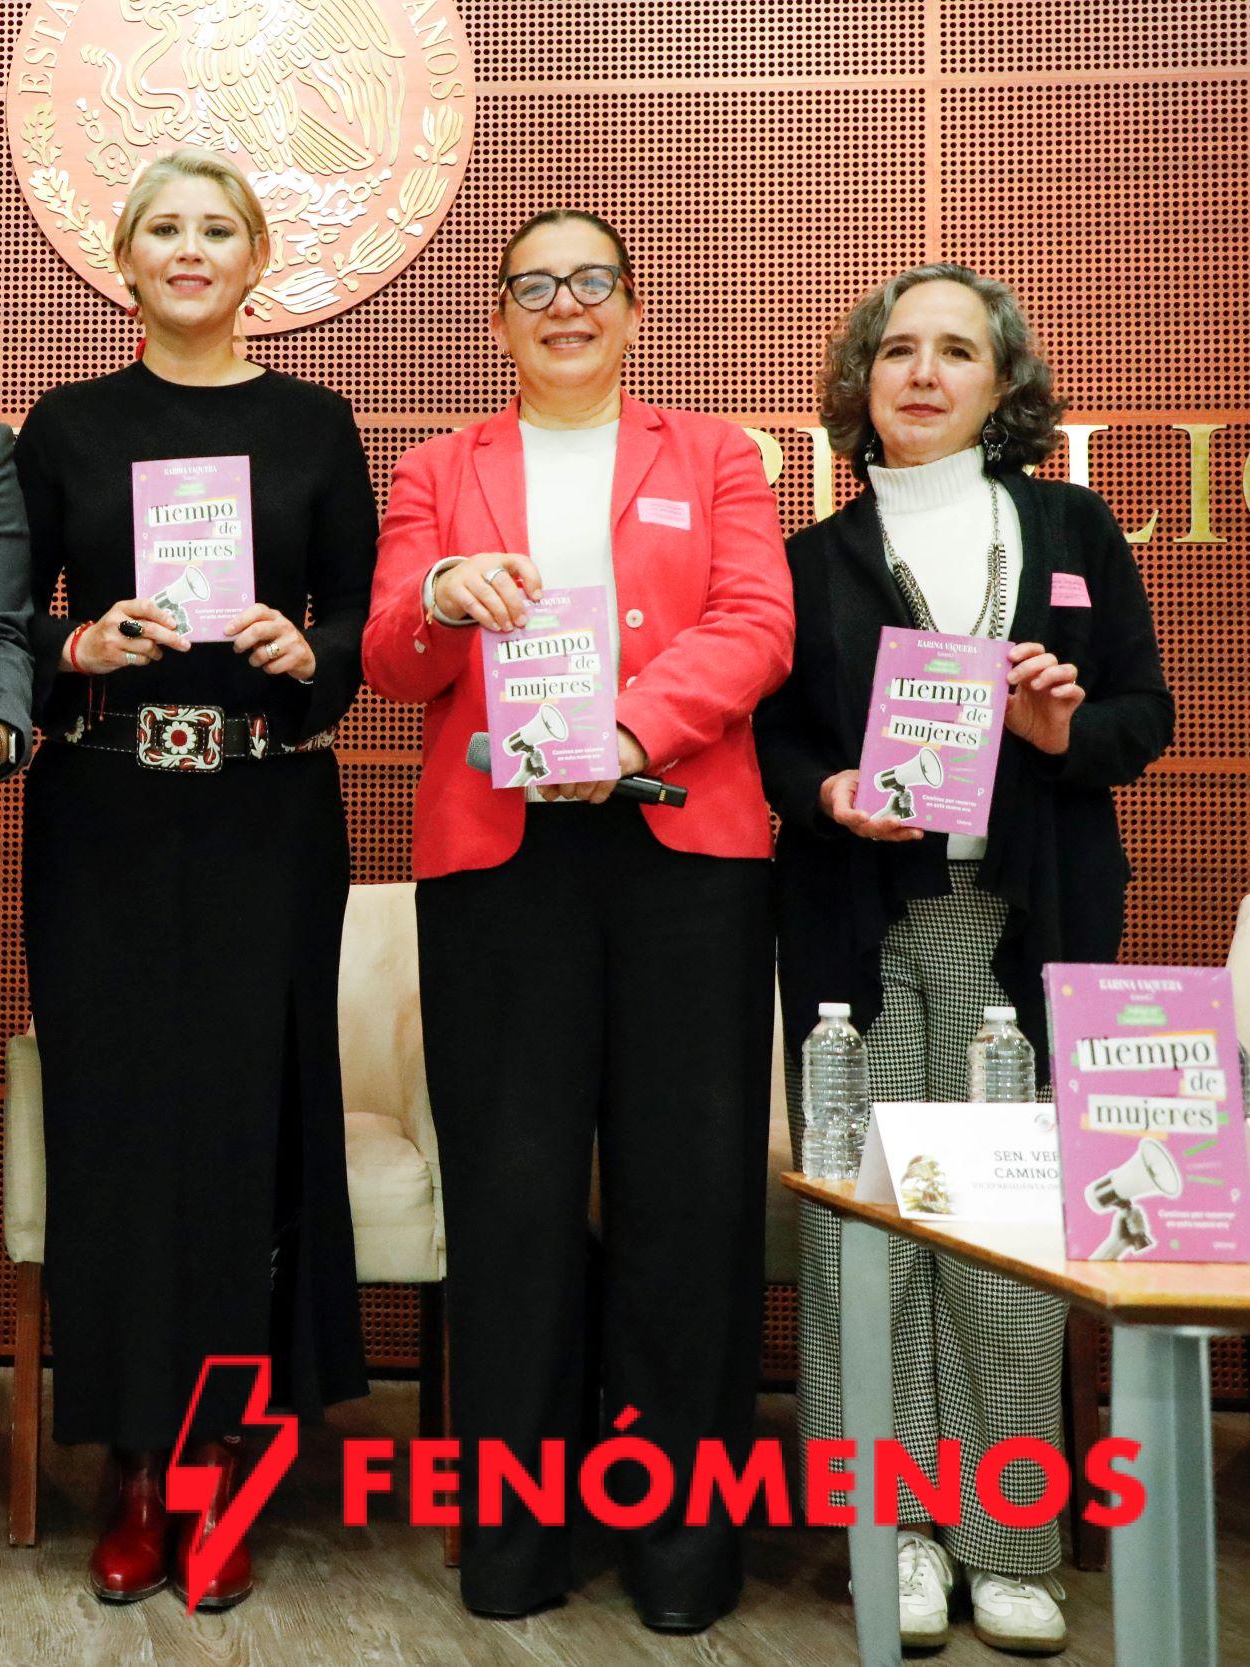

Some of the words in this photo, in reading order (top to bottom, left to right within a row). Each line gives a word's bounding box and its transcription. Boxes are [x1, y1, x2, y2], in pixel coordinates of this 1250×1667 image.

[150, 502, 233, 523] Tiempo
[219, 522, 237, 535] de
[158, 542, 233, 561] mujeres
[501, 634, 590, 661] Tiempo
[575, 657, 595, 670] de
[510, 678, 591, 700] mujeres
[895, 677, 987, 705] Tiempo
[966, 708, 987, 723] de
[894, 721, 977, 745] mujeres
[1082, 1036, 1211, 1071] Tiempo
[1190, 1071, 1217, 1094] de
[1096, 1100, 1213, 1131] mujeres
